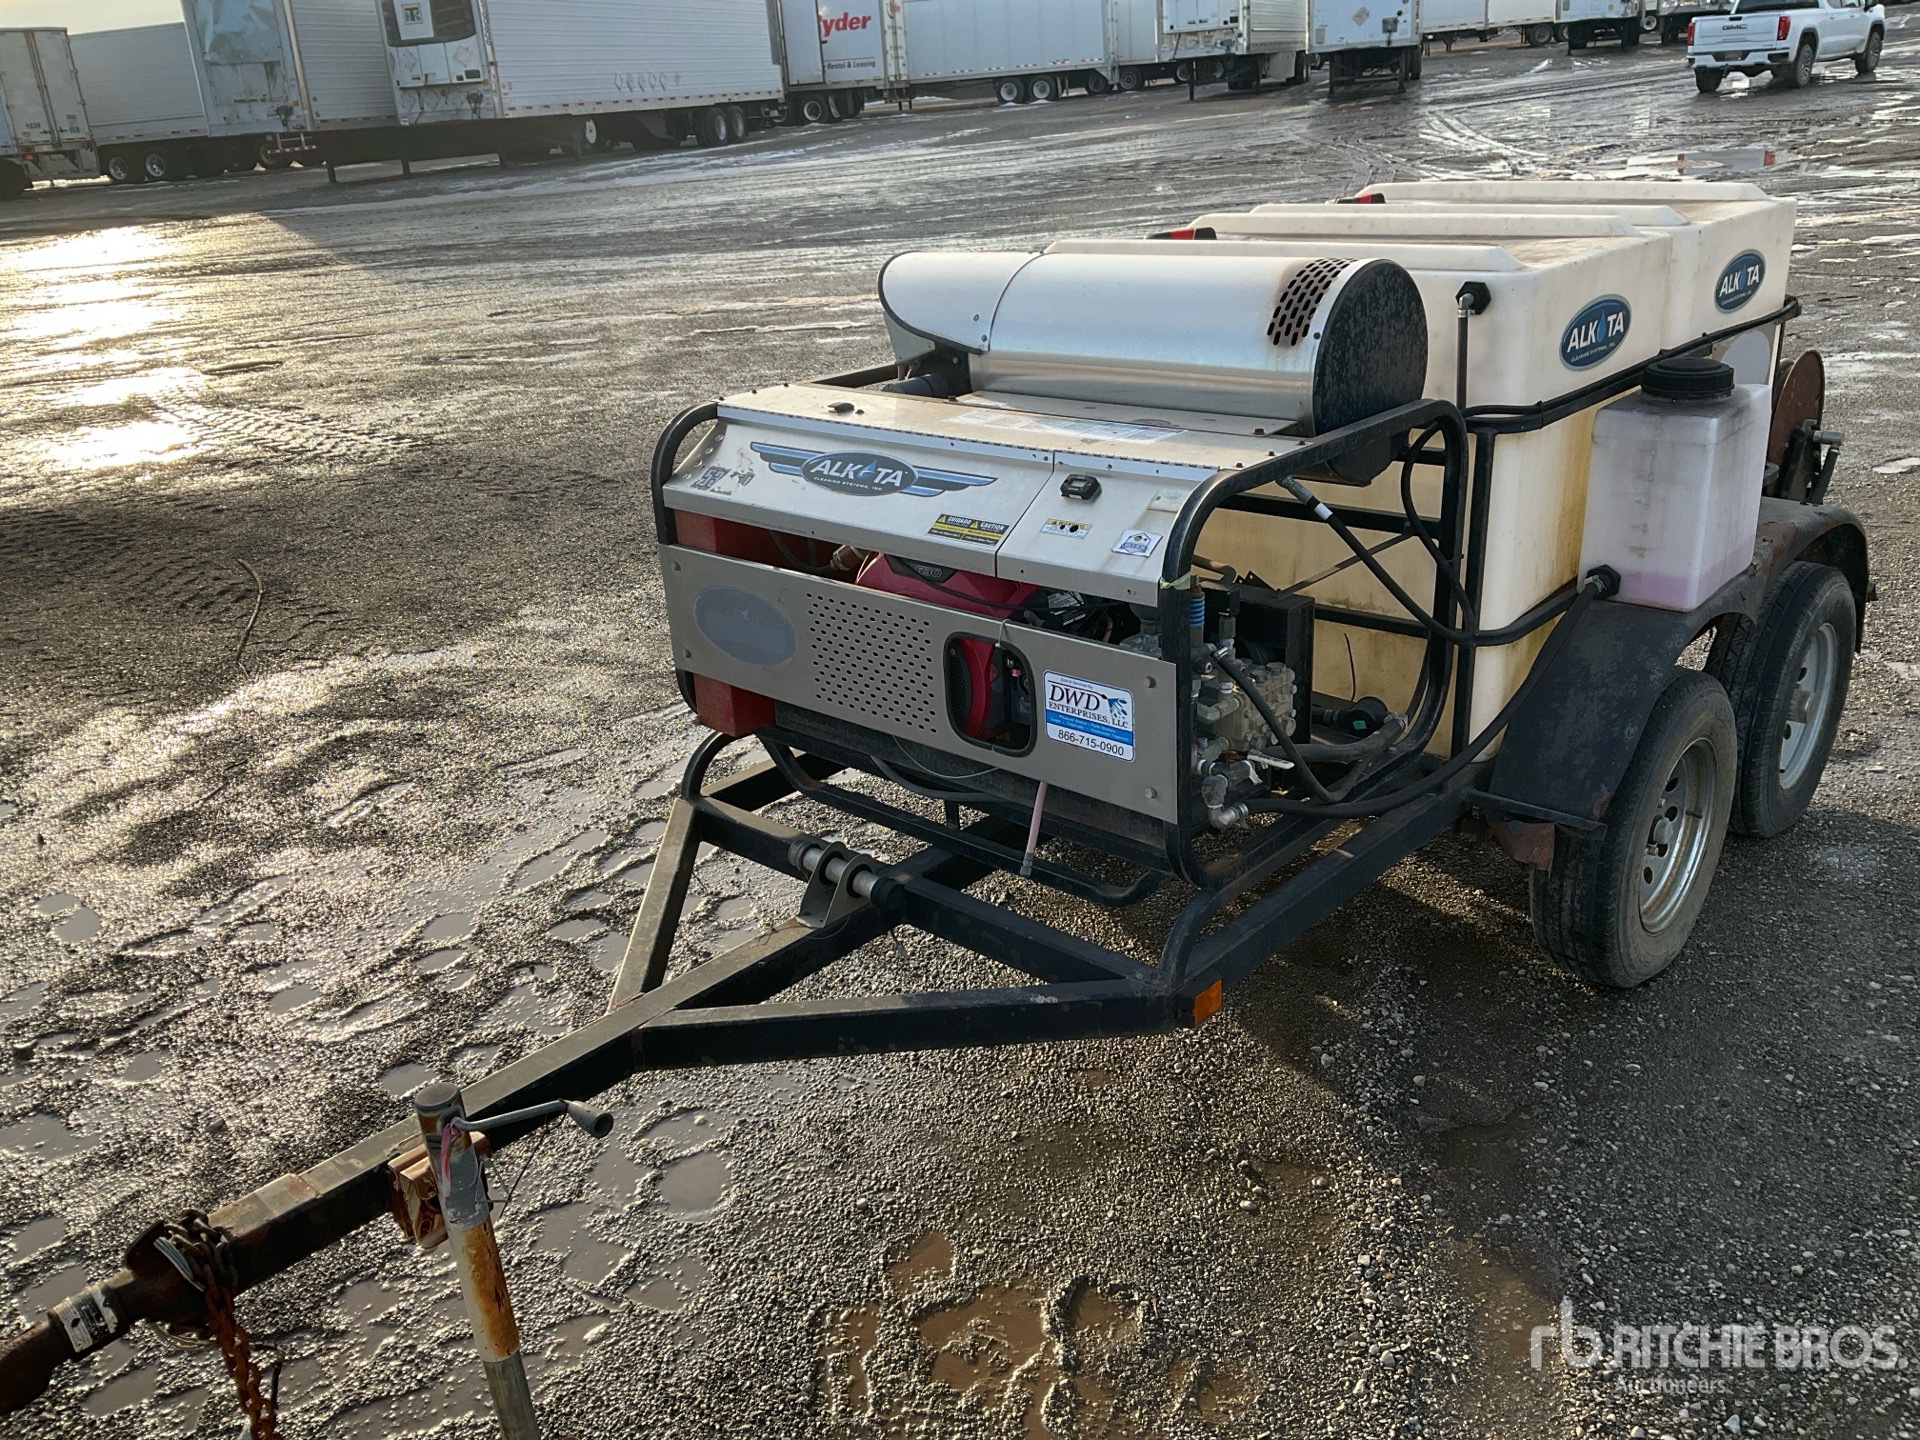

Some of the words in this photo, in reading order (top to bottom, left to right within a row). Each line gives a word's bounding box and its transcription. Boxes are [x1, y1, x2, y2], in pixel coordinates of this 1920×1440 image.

[853, 60, 876, 69] Leasing
[980, 522, 1005, 531] CAUTION
[1049, 684, 1100, 711] DWD
[1048, 701, 1111, 724] ENTERPRISES,
[1112, 717, 1128, 728] LLC
[1057, 729, 1125, 756] 866-715-0900
